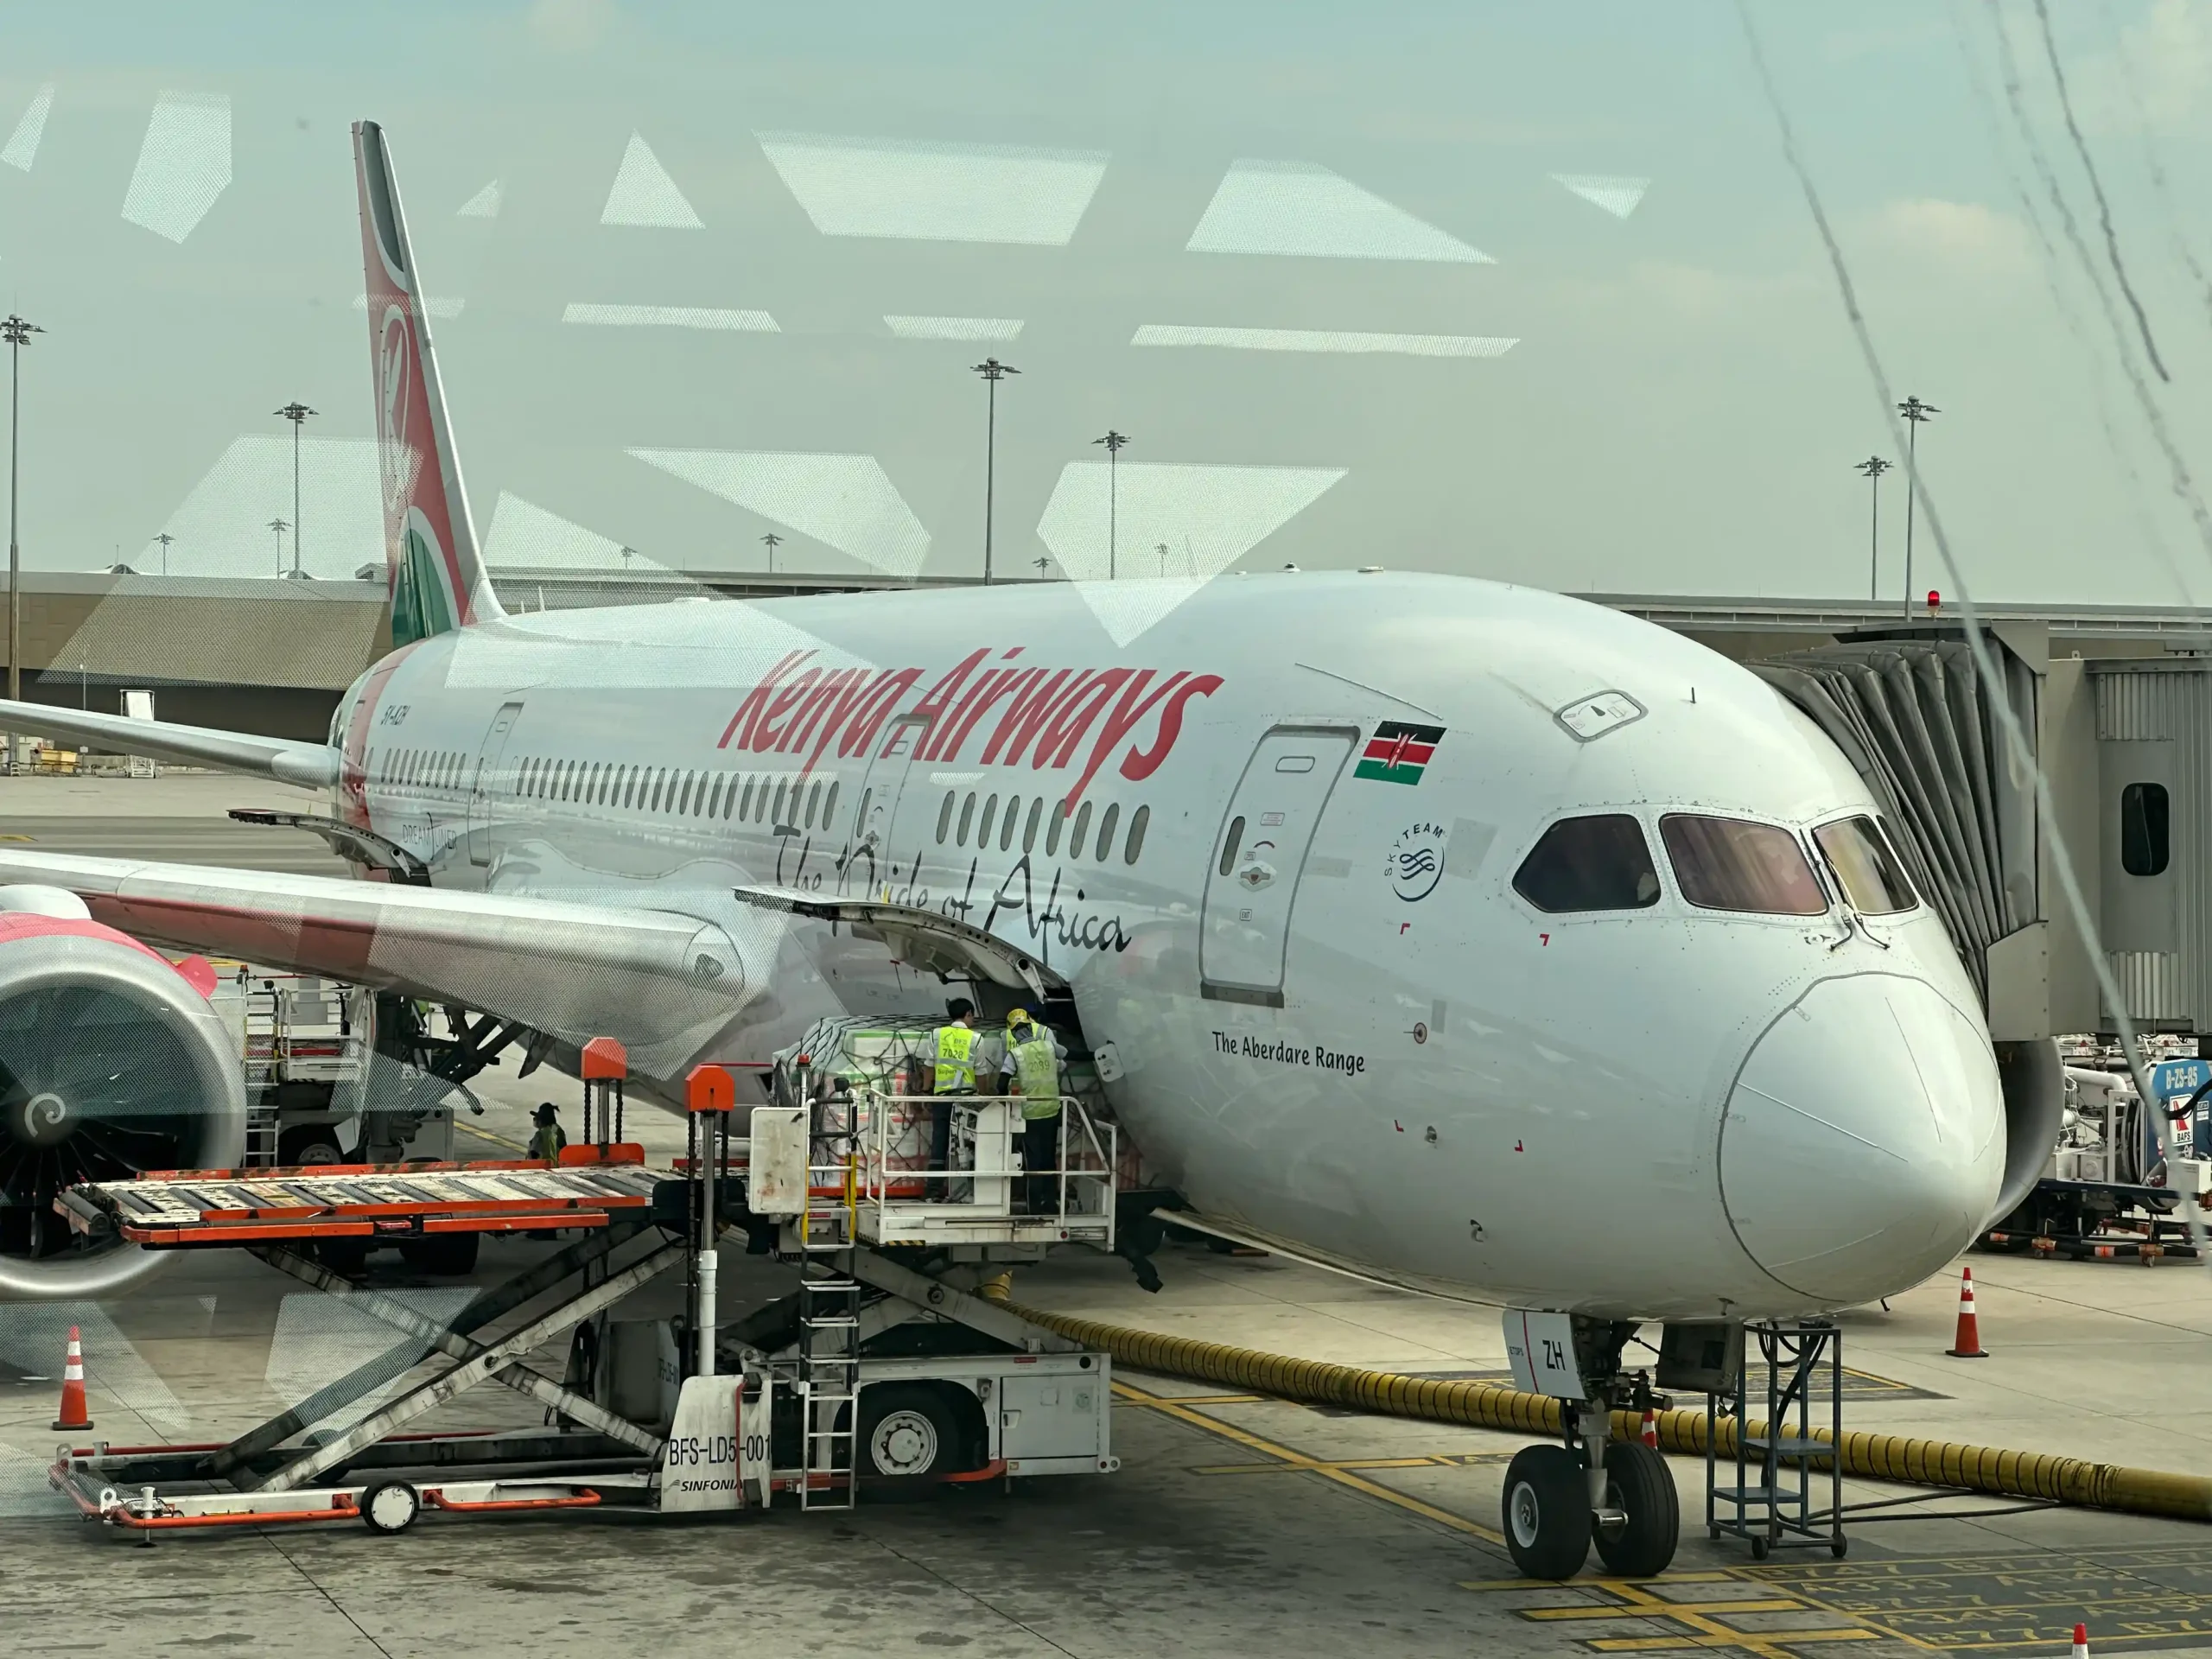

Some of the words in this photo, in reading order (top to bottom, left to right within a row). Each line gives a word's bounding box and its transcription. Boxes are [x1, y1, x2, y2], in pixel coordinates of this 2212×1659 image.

[717, 649, 925, 793] Kenya
[880, 646, 1225, 818] Airways
[773, 824, 823, 889] The
[941, 856, 975, 921] of
[983, 853, 1133, 966] Africa
[942, 1048, 964, 1060] 7028
[1212, 1031, 1238, 1055] The
[1243, 1036, 1310, 1066] Aberdare
[1316, 1046, 1365, 1077] Range
[2165, 1065, 2198, 1090] B-ZS-85
[2177, 1131, 2191, 1142] BAFS
[1541, 1339, 1566, 1371] ZH
[669, 1433, 771, 1466] BFS-LD5-001
[1747, 1564, 1903, 1580] B747
[1800, 1578, 1952, 1594] A333
